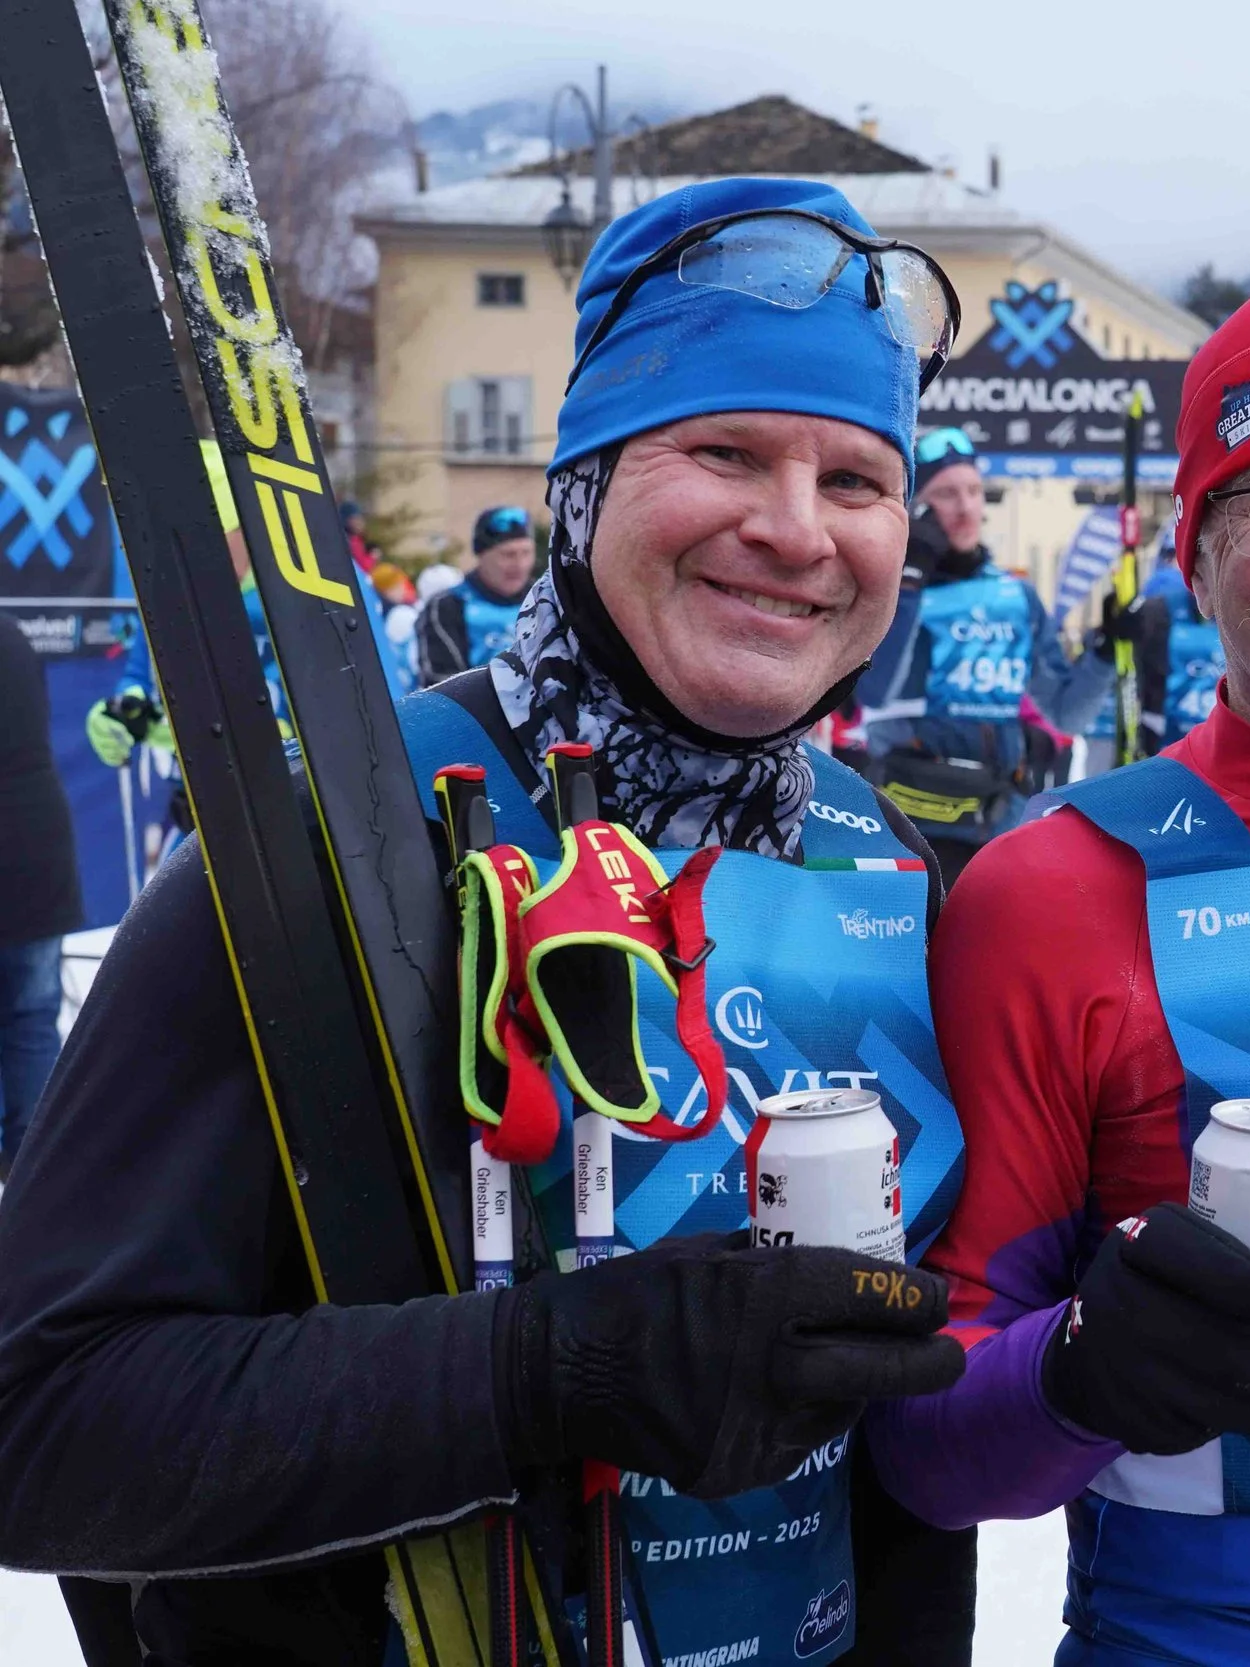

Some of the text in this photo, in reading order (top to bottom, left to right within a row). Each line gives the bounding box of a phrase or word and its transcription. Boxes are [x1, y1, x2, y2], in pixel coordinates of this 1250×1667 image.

[1230, 400, 1241, 411] UP
[1234, 424, 1250, 439] SKI
[946, 656, 1026, 694] 4942
[808, 800, 881, 834] coop
[584, 827, 652, 923] LEKI
[1177, 906, 1250, 940] 70 KM
[576, 1143, 590, 1214] Grieshaber
[595, 1166, 607, 1191] Ken
[475, 1166, 490, 1238] Grieshaber
[494, 1190, 507, 1215] Ken
[856, 1225, 889, 1240] ICHNUSA
[852, 1270, 922, 1308] TOKO
[646, 1530, 751, 1562] EDITION
[774, 1511, 821, 1543] 2025
[800, 1596, 849, 1643] Melinda
